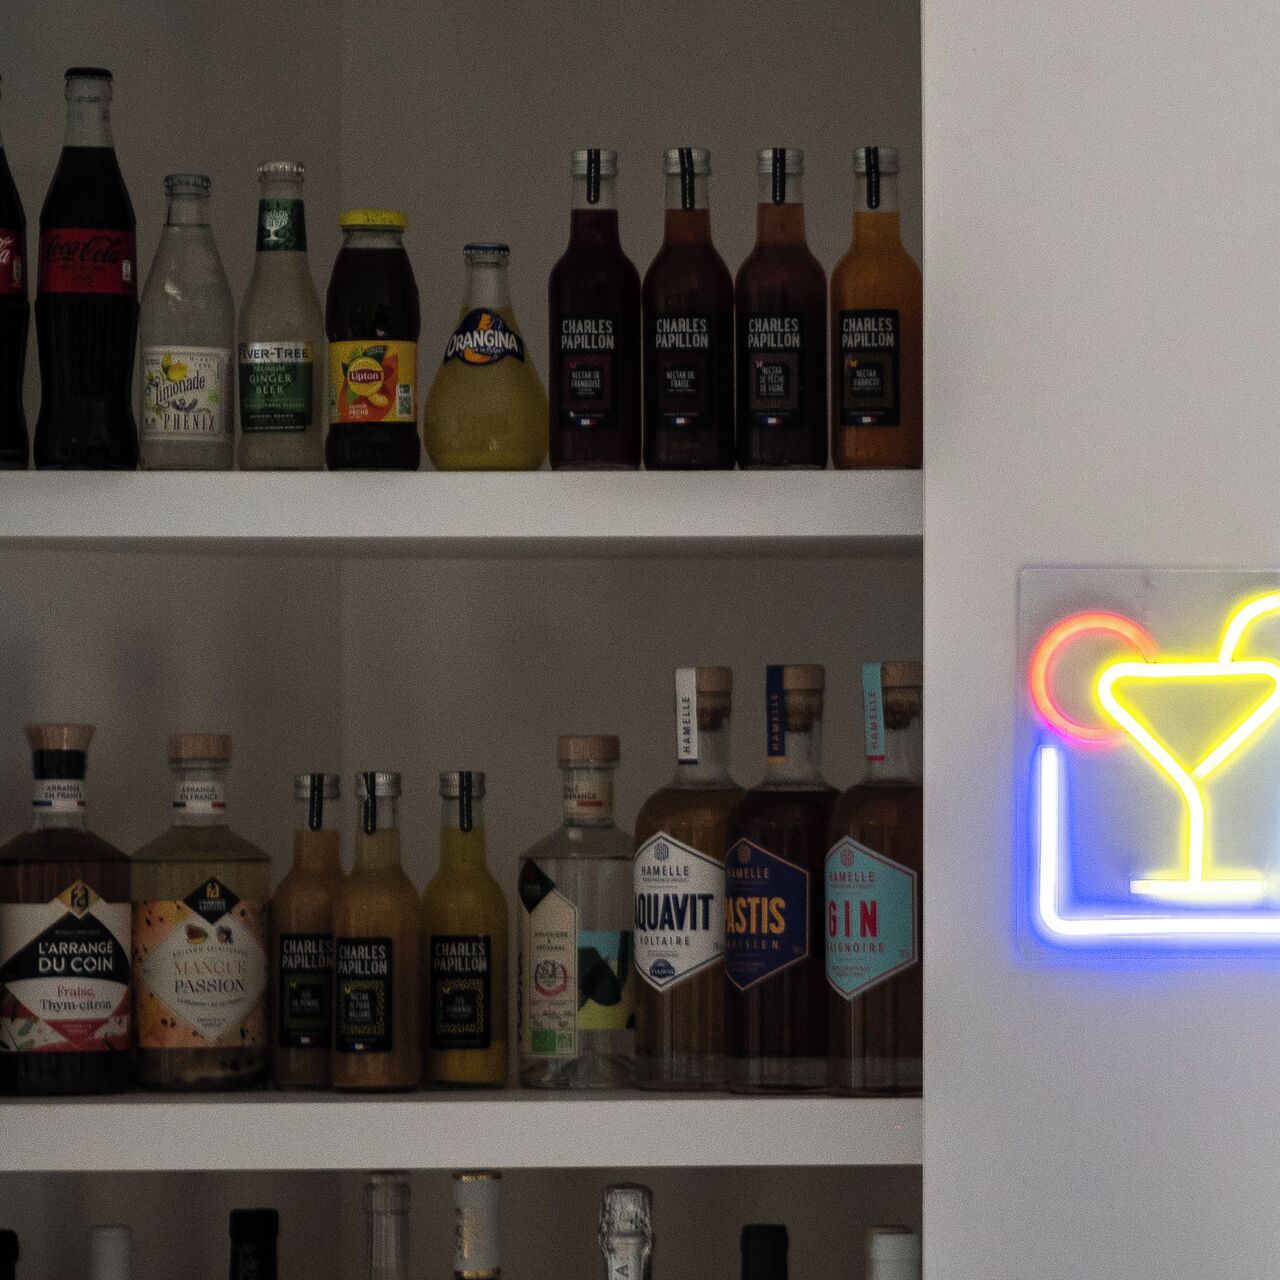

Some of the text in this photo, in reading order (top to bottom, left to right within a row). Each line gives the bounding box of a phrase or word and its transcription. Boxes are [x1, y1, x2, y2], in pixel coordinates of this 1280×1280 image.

[562, 319, 613, 334] CHARLES
[656, 317, 707, 333] CHARLES
[748, 317, 799, 333] CHARLES
[842, 317, 893, 332] CHARLES
[447, 329, 519, 357] ORANGINA
[561, 334, 615, 350] PAPILLON
[655, 333, 709, 349] PAPILLON
[747, 332, 801, 348] PAPILLON
[841, 332, 895, 347] PAPILLON
[249, 373, 293, 384] GINGER
[351, 372, 380, 381] Lipton
[571, 369, 594, 380] NECTAR
[665, 369, 687, 380] NECTAR
[761, 366, 783, 376] NECTAR
[255, 384, 284, 395] BEER
[164, 413, 215, 431] PHENIX
[682, 697, 691, 753] HAMELLE
[771, 693, 779, 751] HAMELLE
[869, 691, 878, 749] HAMELLE
[641, 866, 689, 877] HAMELLE
[828, 871, 874, 882] HAMELLE
[726, 896, 786, 935] ASTIS
[829, 900, 877, 939] GIN
[38, 939, 113, 955] L'ARRANGÉ
[640, 935, 691, 946] VOLTAIRE
[339, 944, 387, 959] CHARLES
[435, 941, 486, 956] CHARLES
[38, 956, 113, 973] DU COIN
[175, 961, 245, 975] MANGUE
[338, 959, 388, 975] PAPILLON
[434, 956, 487, 973] PAPILLON
[175, 979, 244, 993] PASSION
[40, 999, 111, 1013] Thym-citron
